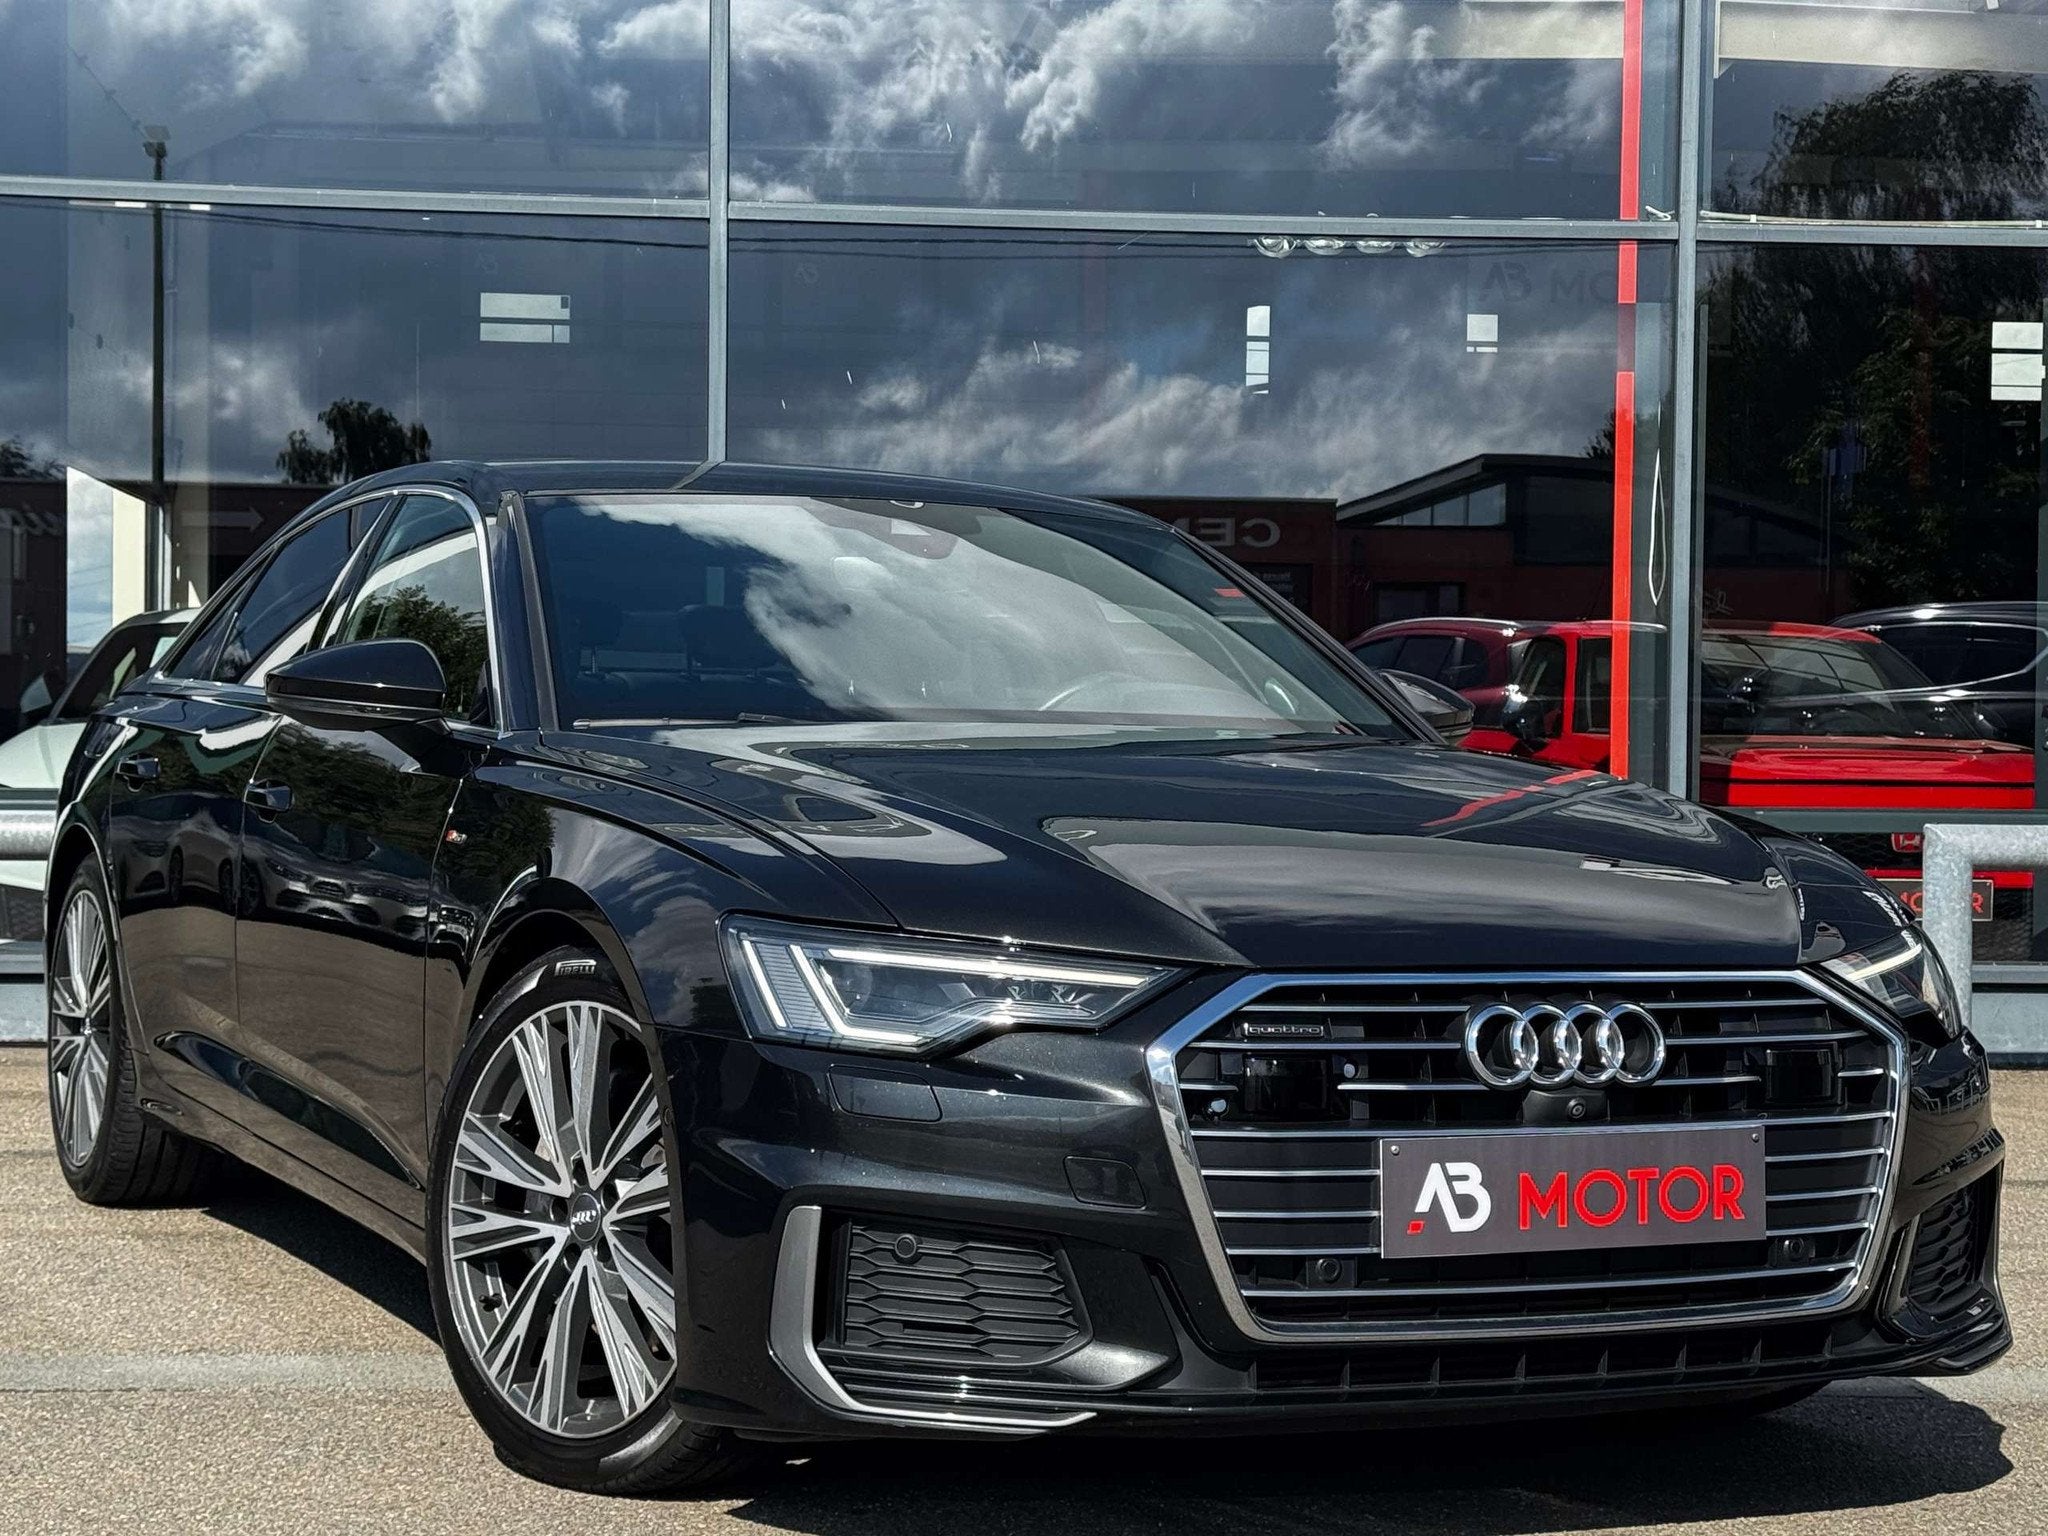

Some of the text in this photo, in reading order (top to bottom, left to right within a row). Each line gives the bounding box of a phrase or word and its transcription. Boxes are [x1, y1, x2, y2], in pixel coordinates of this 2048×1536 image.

[554, 959, 597, 976] PIRELLI
[1249, 1025, 1321, 1035] quattro
[1407, 1161, 1746, 1235] AB MOTOR
